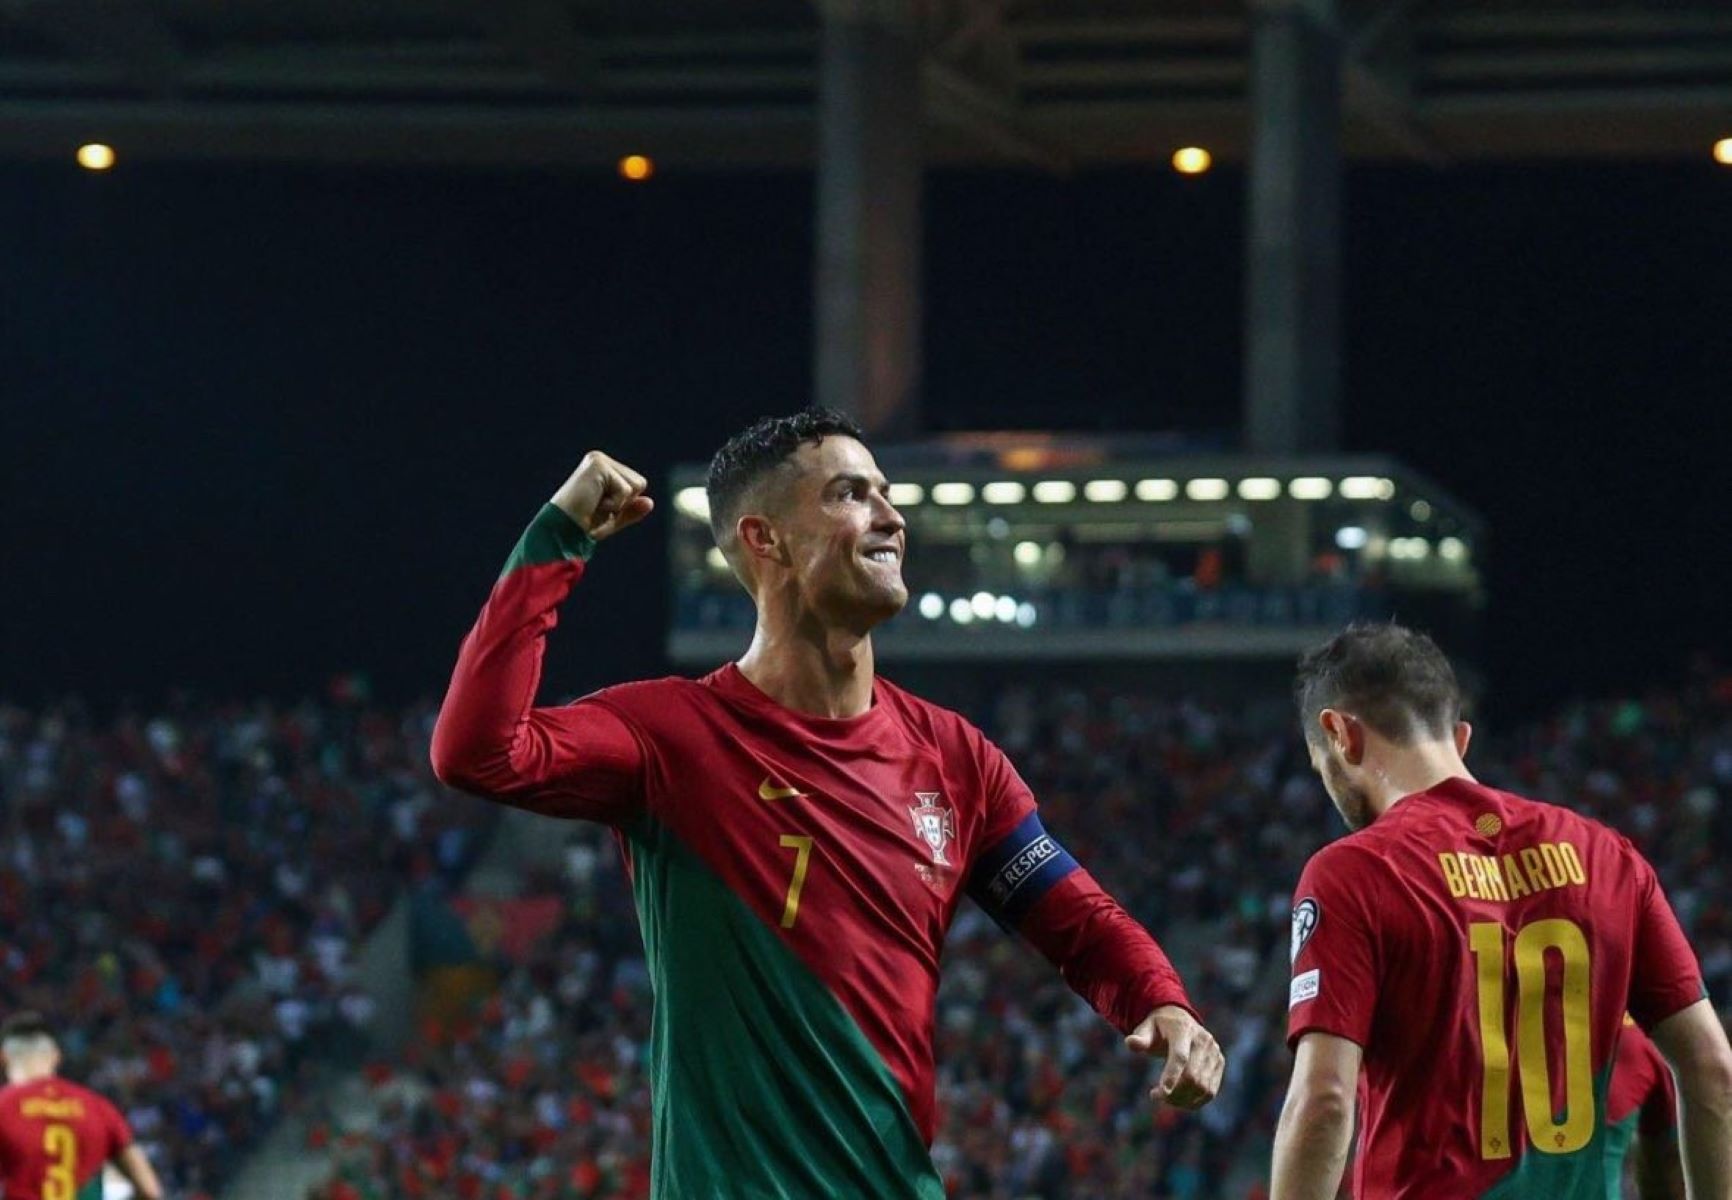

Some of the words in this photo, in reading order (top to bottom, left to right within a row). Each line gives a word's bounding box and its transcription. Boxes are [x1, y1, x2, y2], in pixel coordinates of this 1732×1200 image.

[779, 834, 812, 928] 7
[1005, 838, 1055, 885] RESPECT
[1438, 842, 1585, 902] BERNARDO
[1469, 918, 1595, 1160] 10
[43, 1124, 75, 1200] 3
